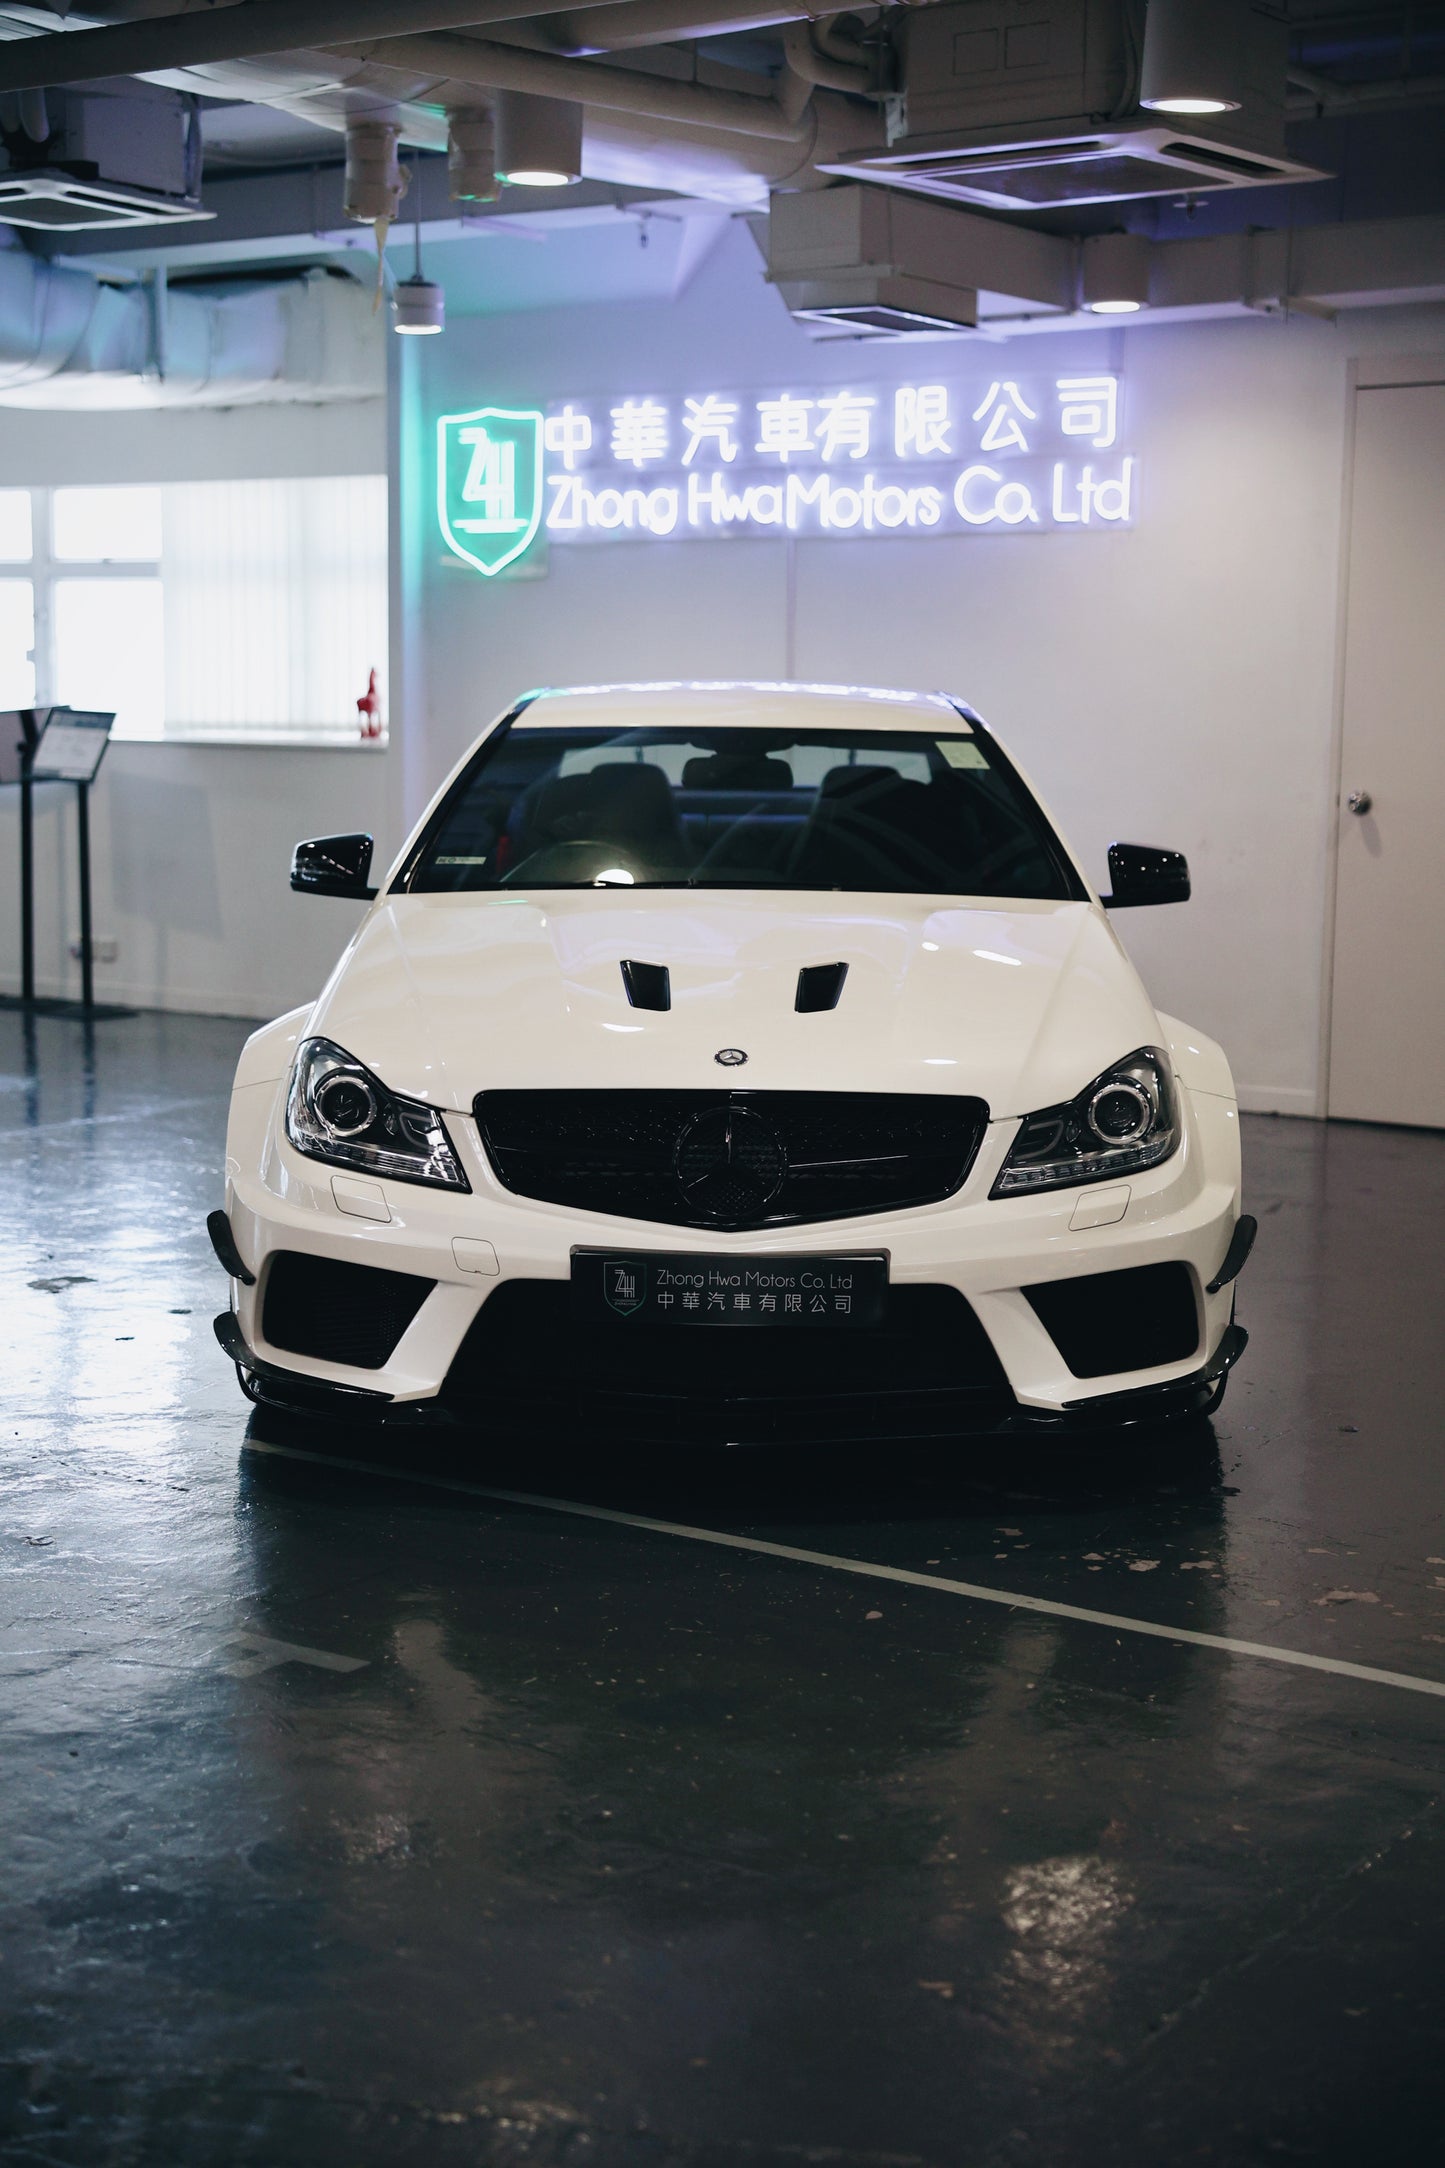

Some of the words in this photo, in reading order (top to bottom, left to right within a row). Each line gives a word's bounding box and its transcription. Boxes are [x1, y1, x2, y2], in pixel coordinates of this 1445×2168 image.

[545, 376, 1118, 470] 中華汽車有限公司
[546, 473, 678, 535] Zhong
[1053, 457, 1132, 524] Ltd
[657, 1269, 704, 1288] Zhong
[708, 1270, 741, 1286] Hwa
[745, 1271, 796, 1288] Motors
[800, 1272, 825, 1289] Co.
[830, 1273, 853, 1289] Ltd
[657, 1290, 852, 1314] 中華汽車有限公司
